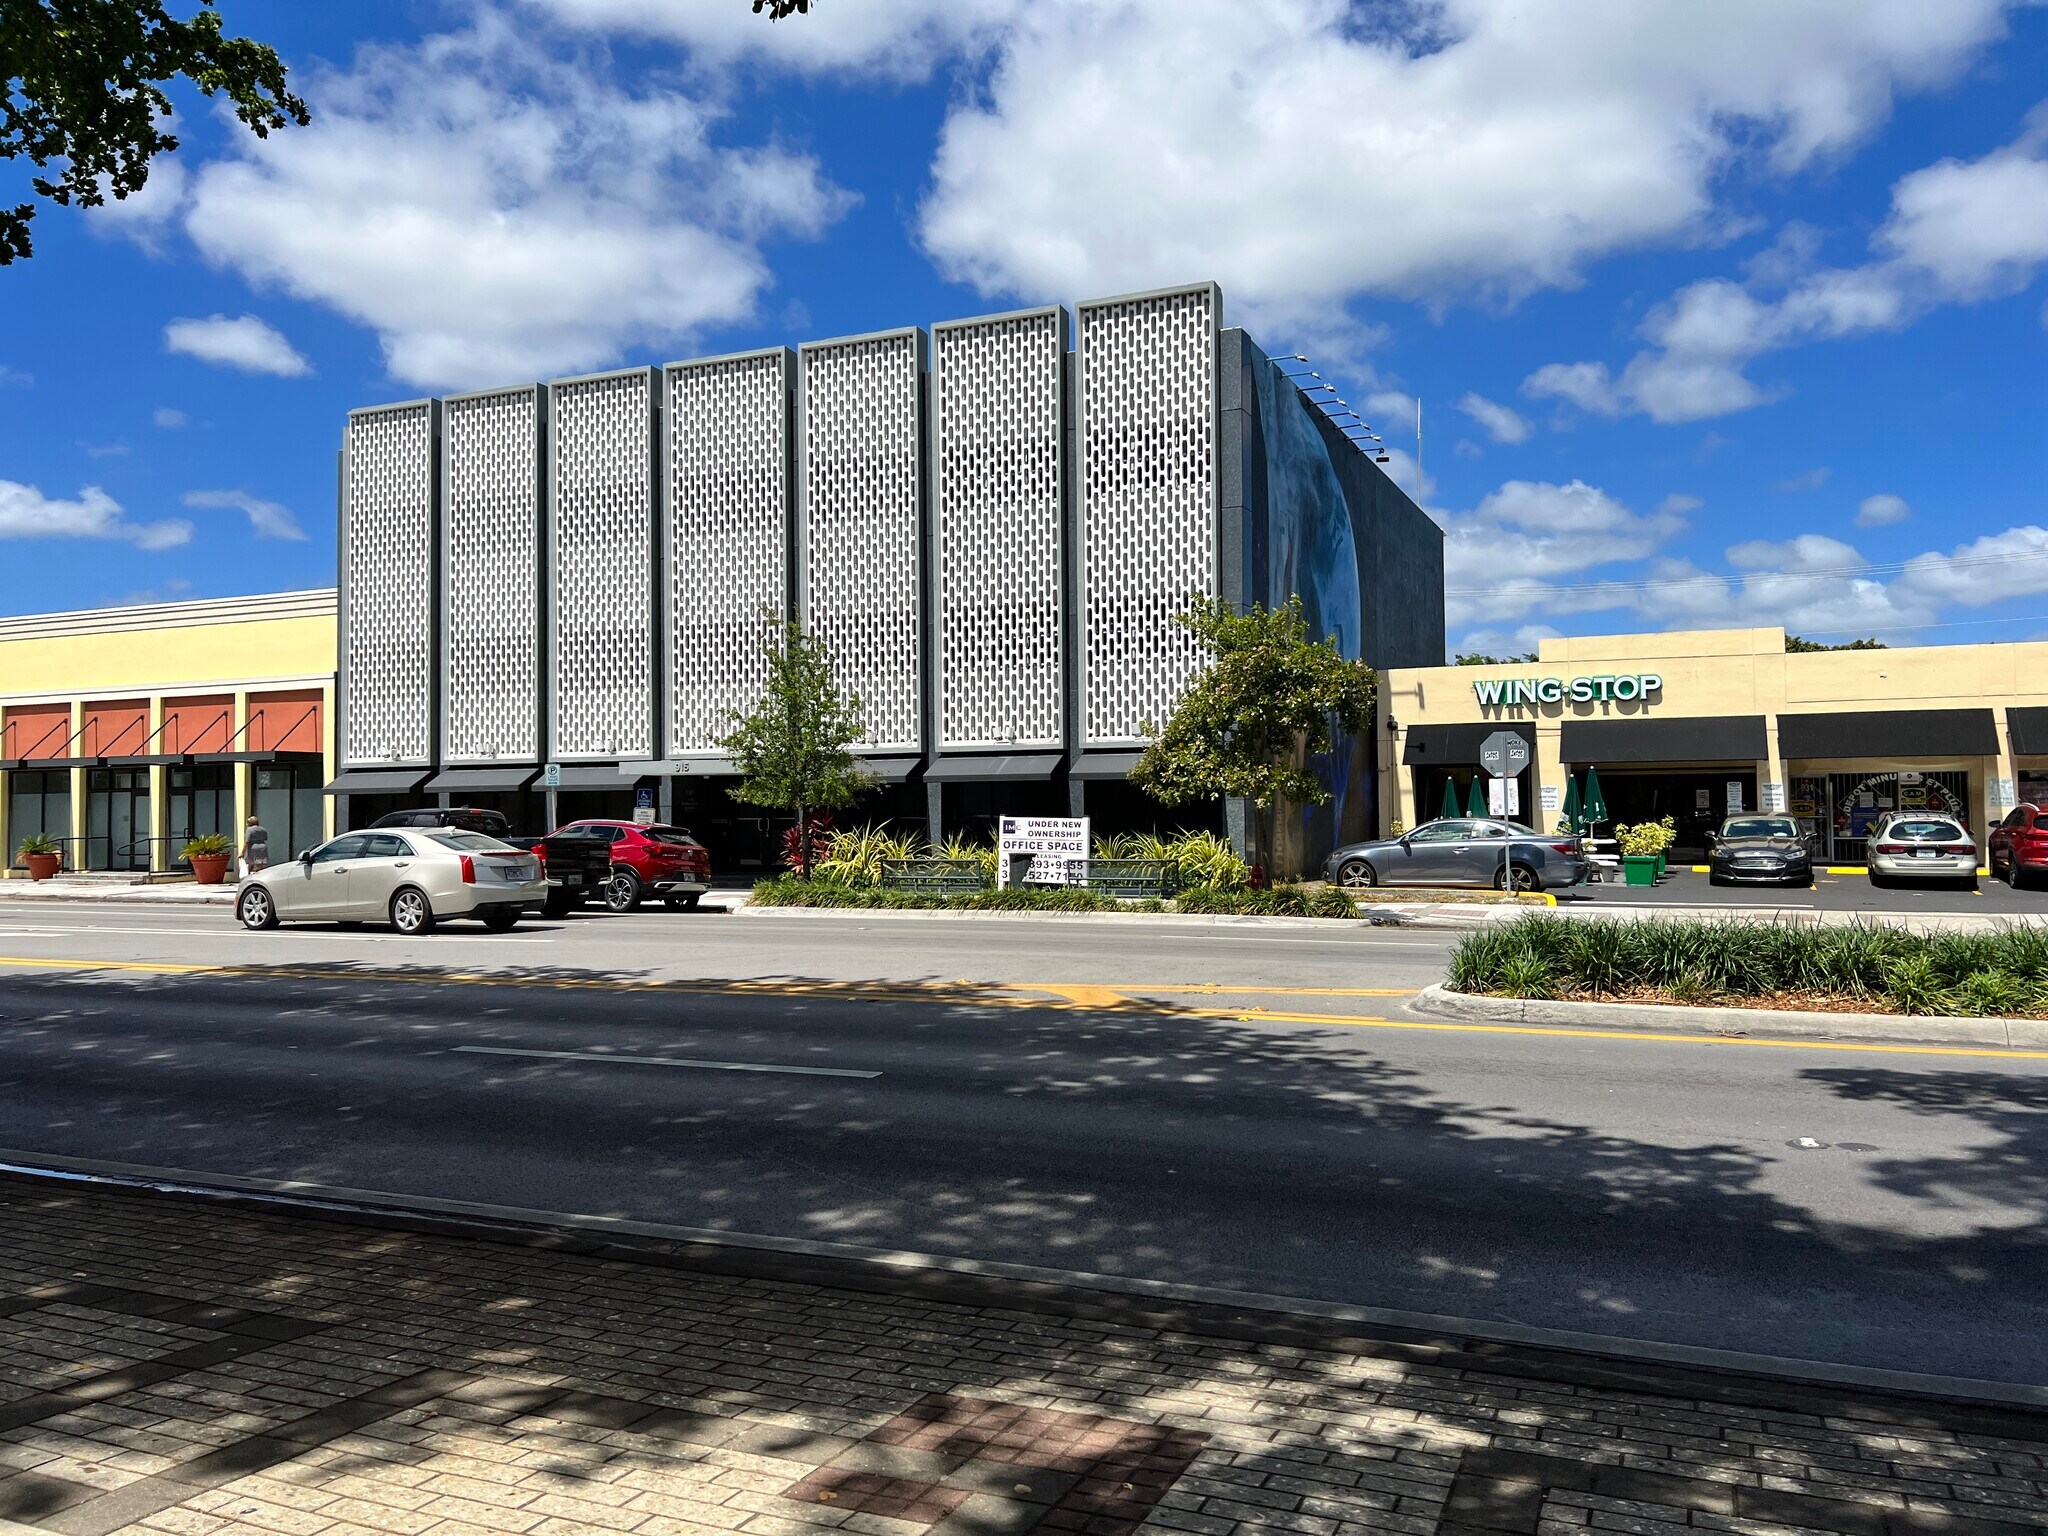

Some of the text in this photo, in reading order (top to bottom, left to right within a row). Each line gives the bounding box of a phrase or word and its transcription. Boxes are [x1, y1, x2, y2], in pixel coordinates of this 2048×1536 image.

[675, 762, 690, 773] 915
[1842, 783, 1867, 813] DEPOT
[1925, 777, 1942, 788] ET
[1940, 787, 1961, 812] PLUS
[1028, 820, 1082, 829] UNDER NEW
[1027, 830, 1082, 838] OWNERSHIP
[1003, 840, 1083, 851] OFFICE SPACE
